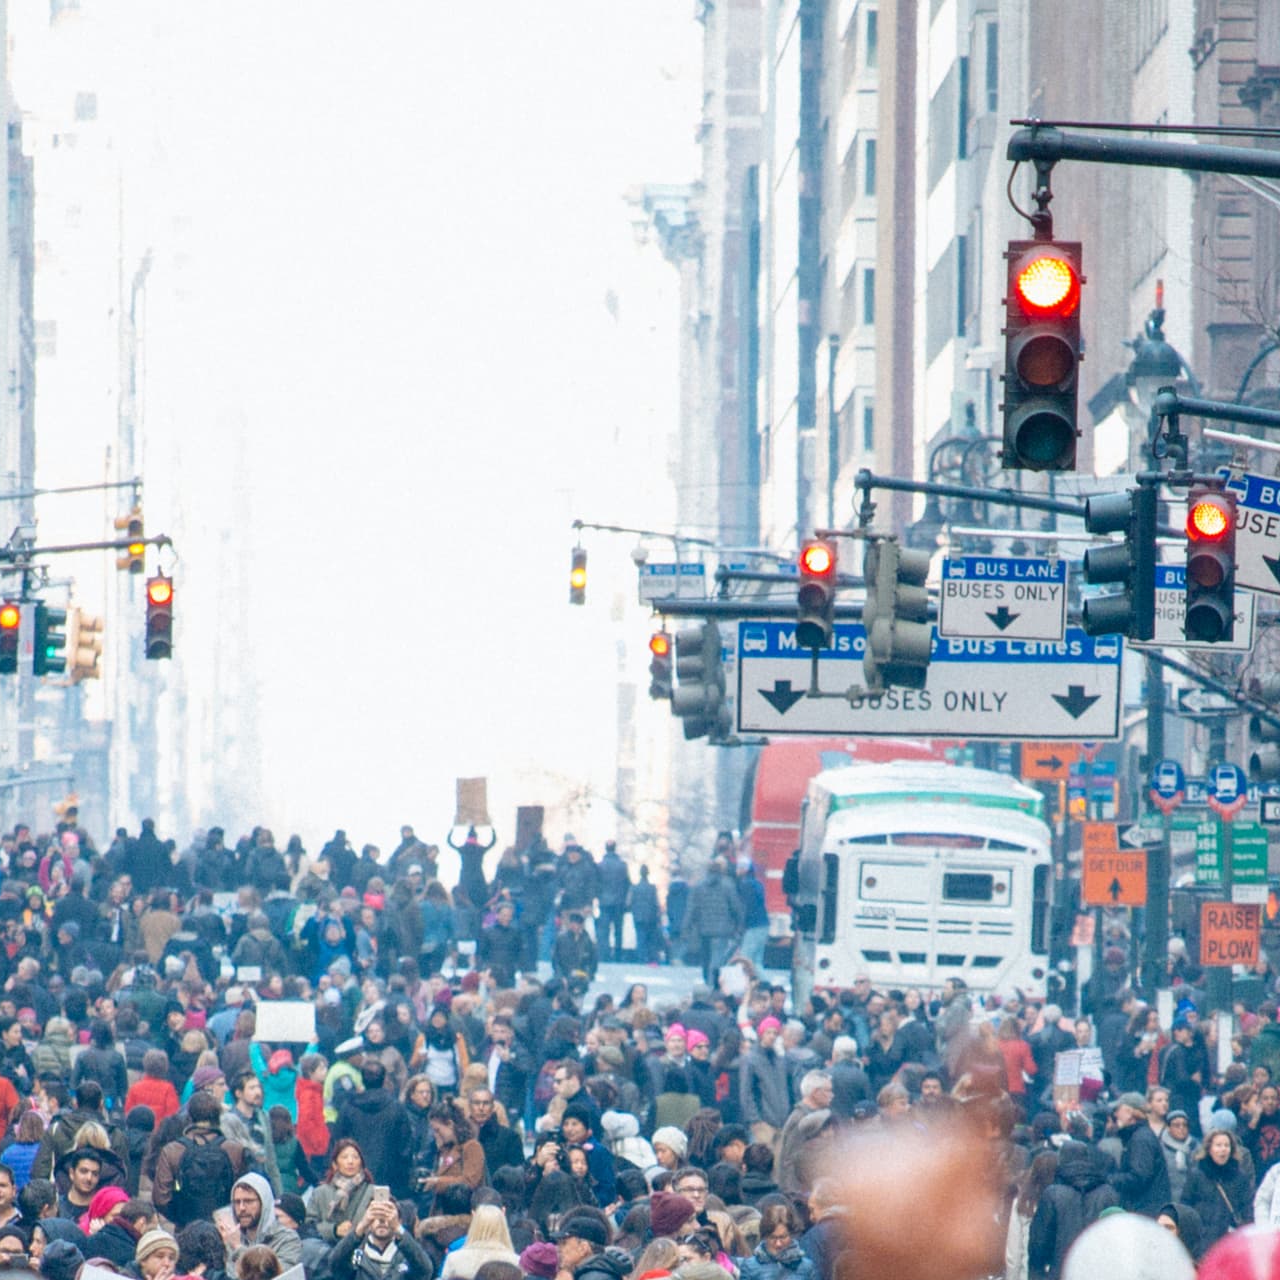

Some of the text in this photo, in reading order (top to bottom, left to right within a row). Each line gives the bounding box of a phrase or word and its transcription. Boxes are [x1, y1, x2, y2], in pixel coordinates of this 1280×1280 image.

[975, 562, 1059, 578] BUS LANE
[1165, 571, 1186, 585] BU
[947, 581, 1060, 602] BUSES ONLY
[1007, 637, 1083, 657] Lanes
[944, 691, 1008, 712] ONLY
[1207, 910, 1254, 930] RAISE
[1207, 939, 1253, 960] PLOW
